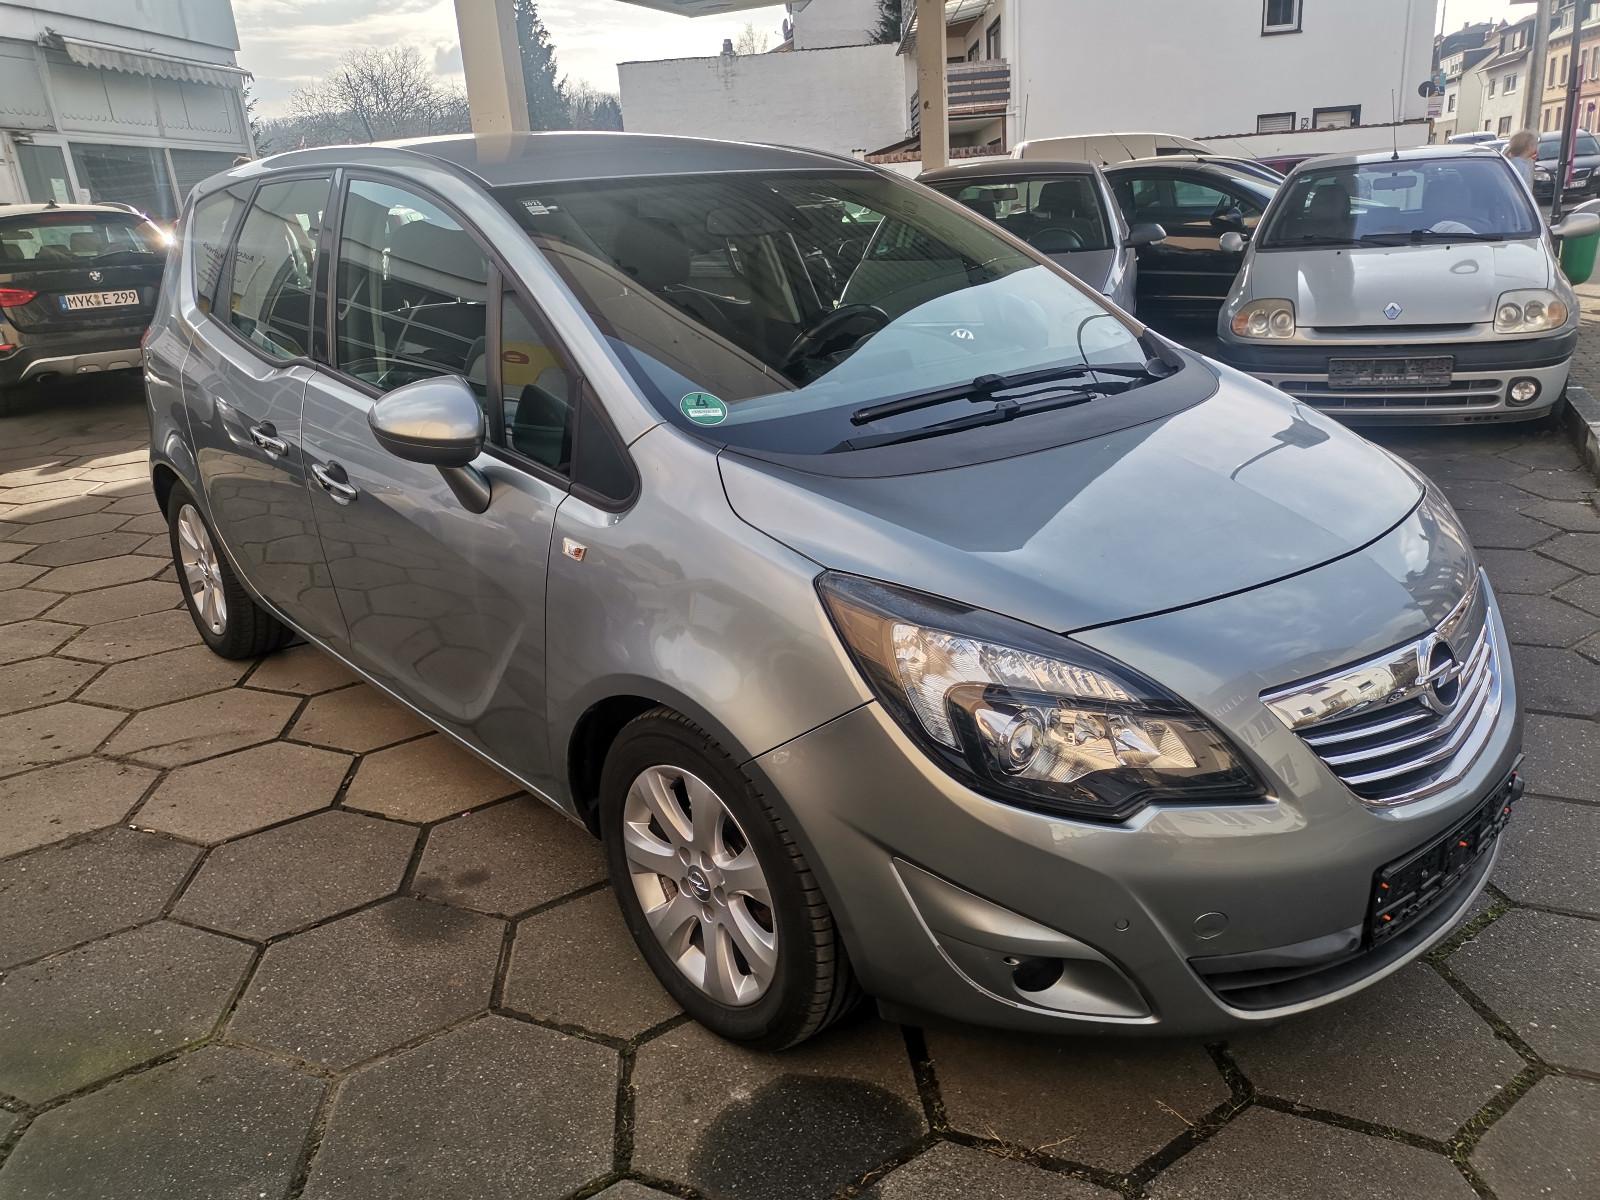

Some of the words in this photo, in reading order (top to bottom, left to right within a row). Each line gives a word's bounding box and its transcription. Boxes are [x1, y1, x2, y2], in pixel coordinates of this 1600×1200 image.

[67, 295, 95, 308] MYK
[102, 293, 112, 305] E
[113, 291, 136, 304] 299
[695, 394, 709, 409] 4
